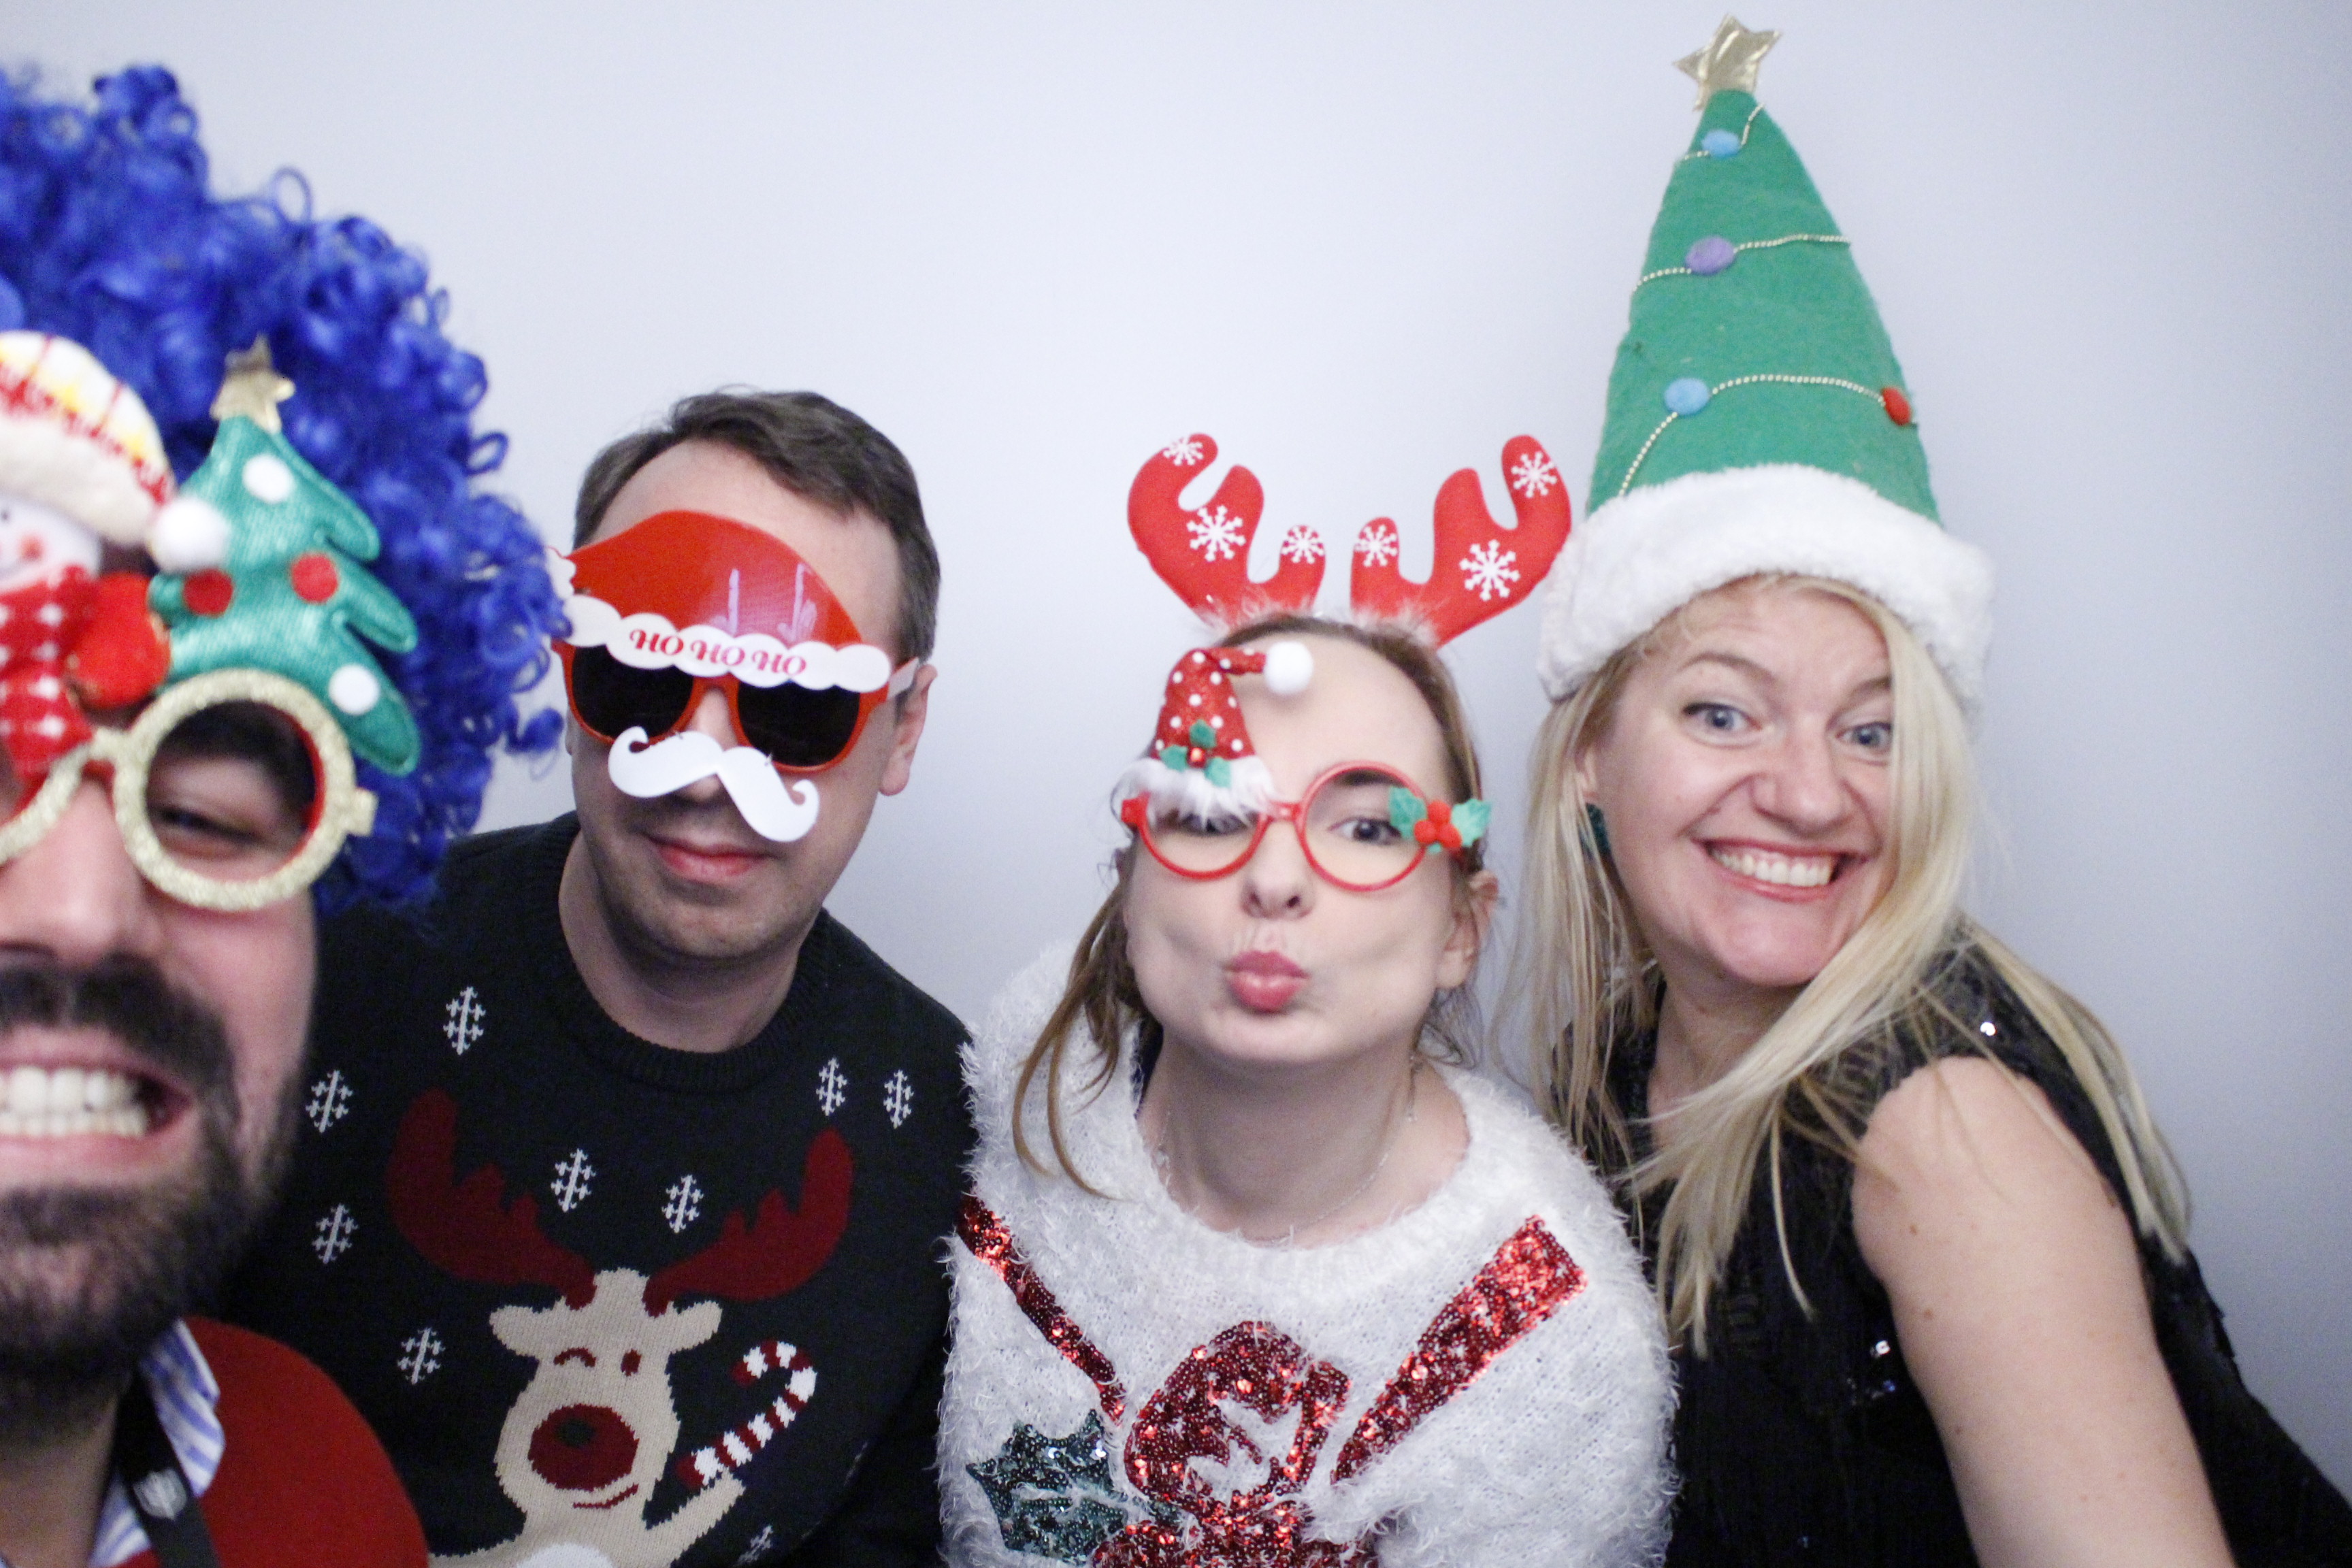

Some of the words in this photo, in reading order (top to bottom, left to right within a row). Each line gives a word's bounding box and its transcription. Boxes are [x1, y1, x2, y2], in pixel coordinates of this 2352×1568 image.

[630, 630, 684, 655] HO
[690, 640, 745, 666] HO
[751, 650, 807, 676] HO
